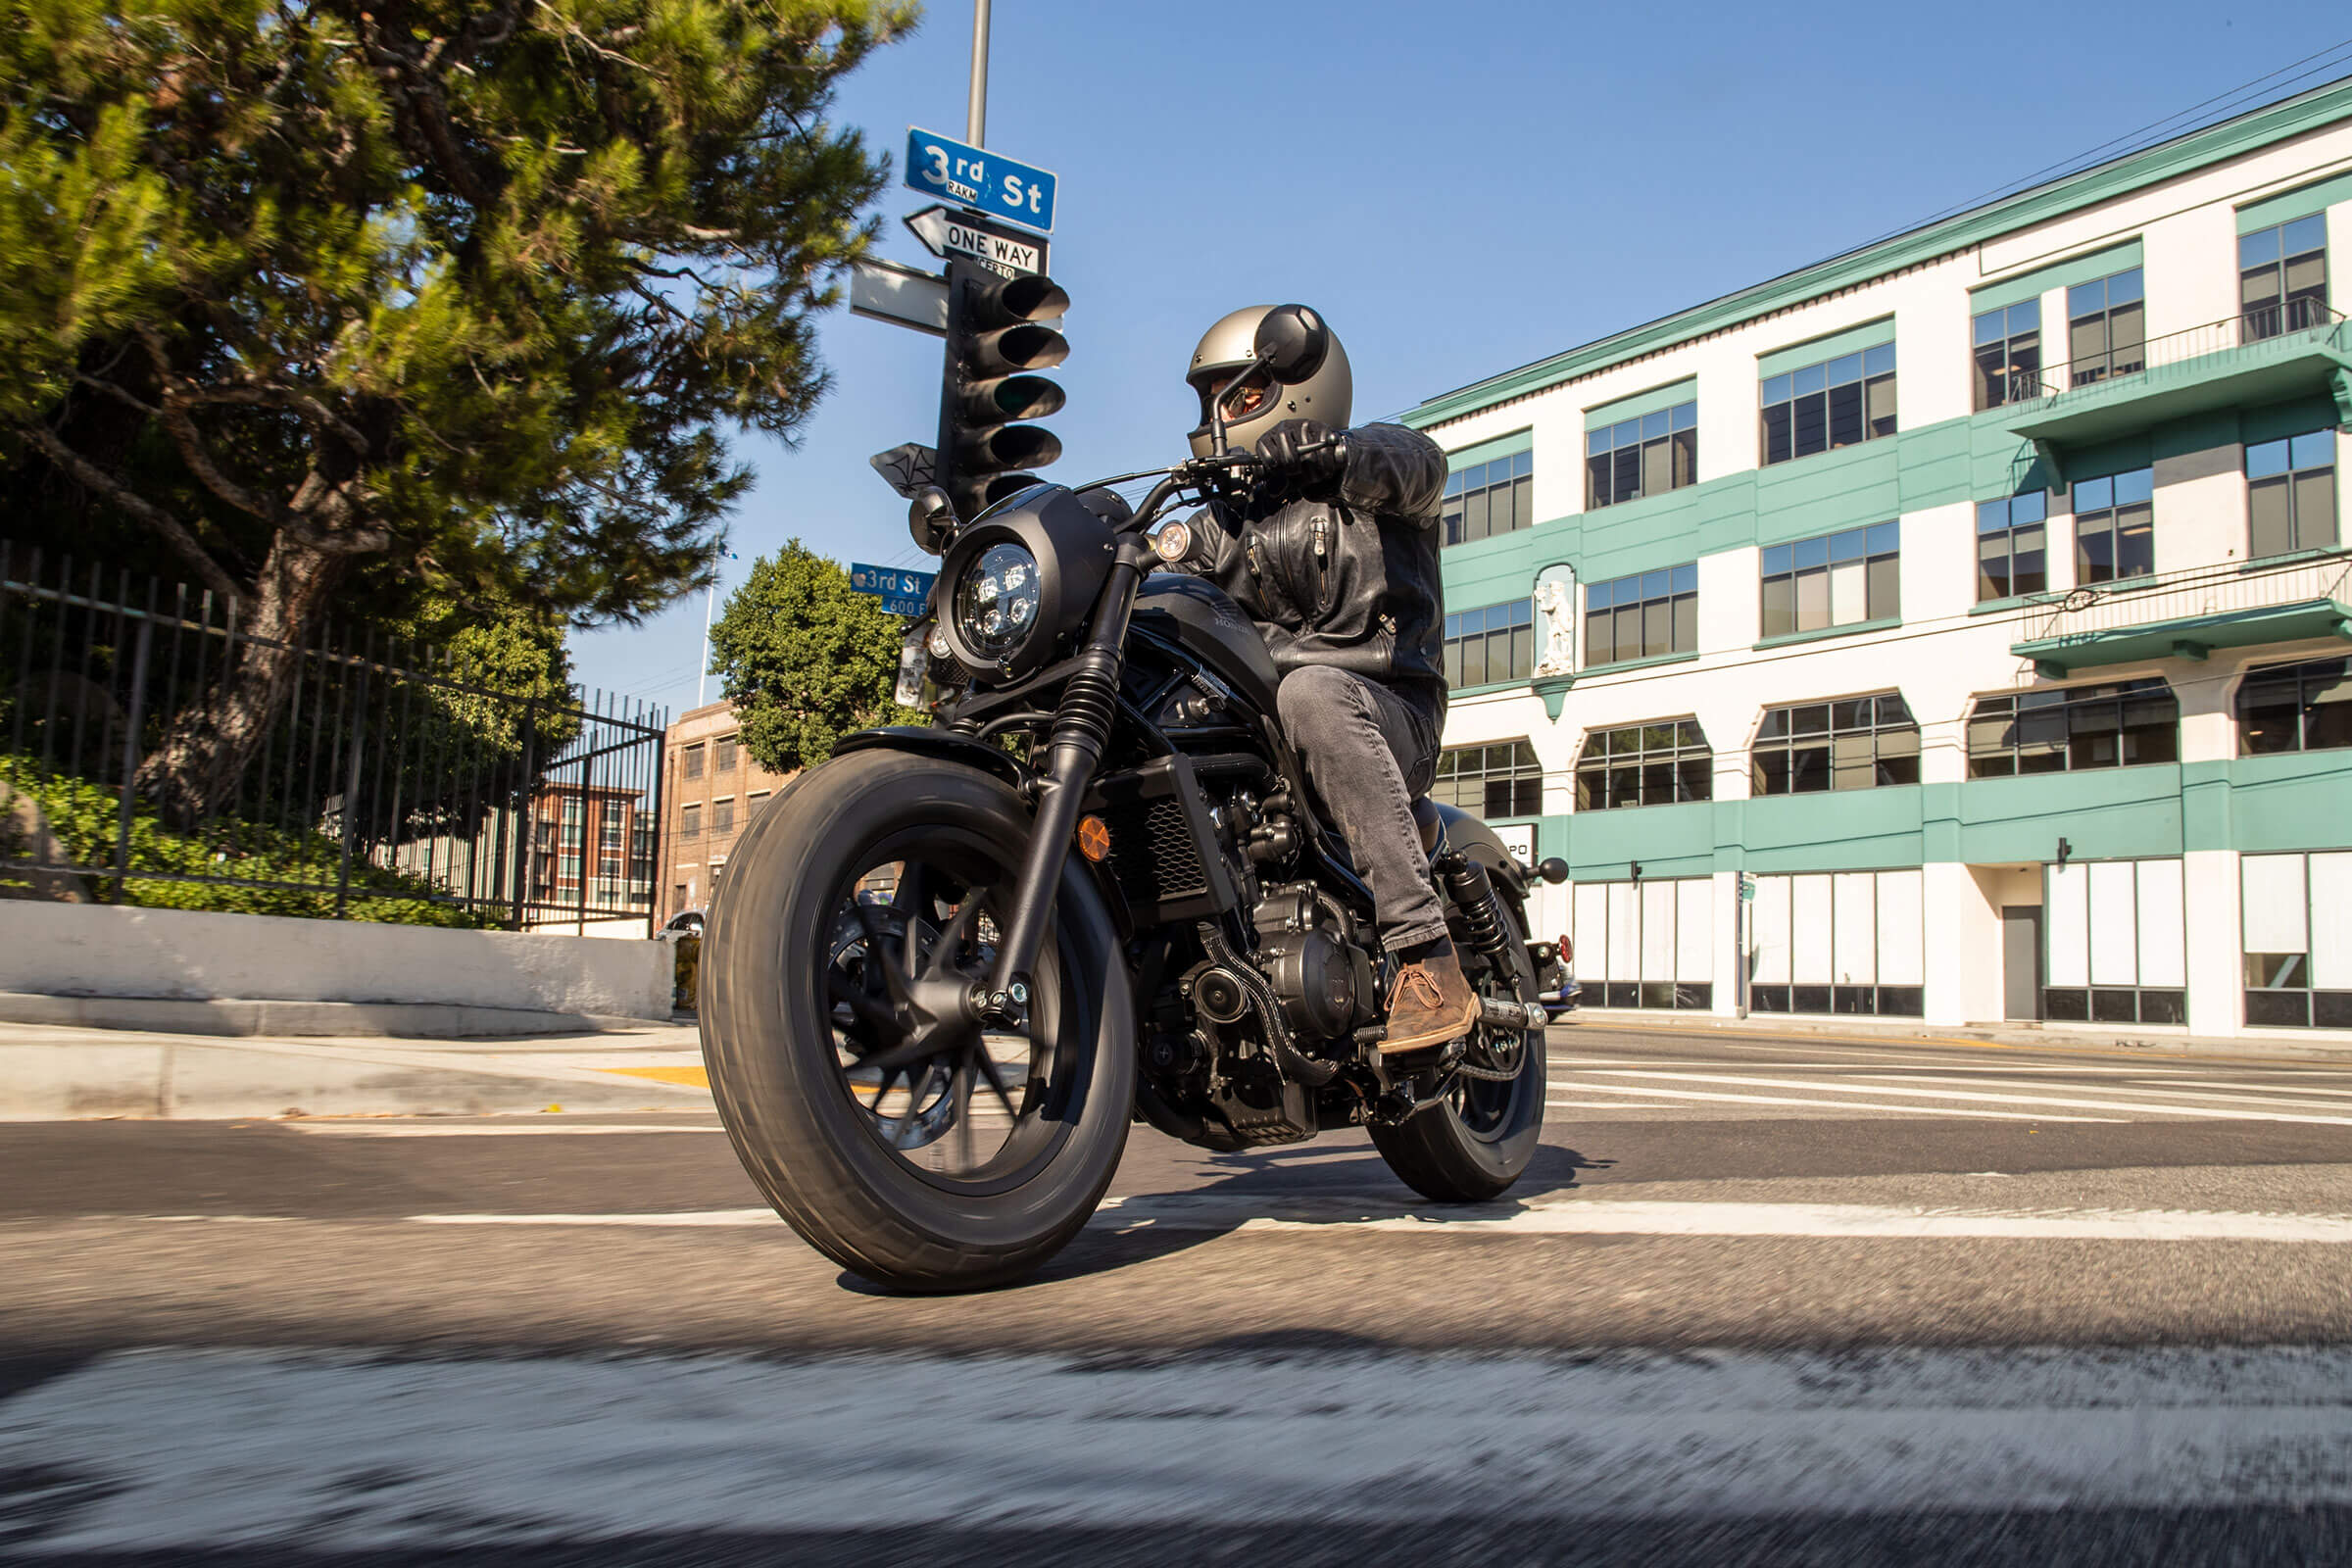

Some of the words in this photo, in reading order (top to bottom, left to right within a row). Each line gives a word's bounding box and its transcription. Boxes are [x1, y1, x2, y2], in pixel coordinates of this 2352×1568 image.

[921, 145, 984, 184] 3rd
[1002, 174, 1042, 214] St
[949, 225, 987, 254] ONE
[995, 239, 1033, 267] WAY
[867, 569, 897, 591] 3rd
[903, 574, 921, 595] St
[890, 600, 914, 614] 600
